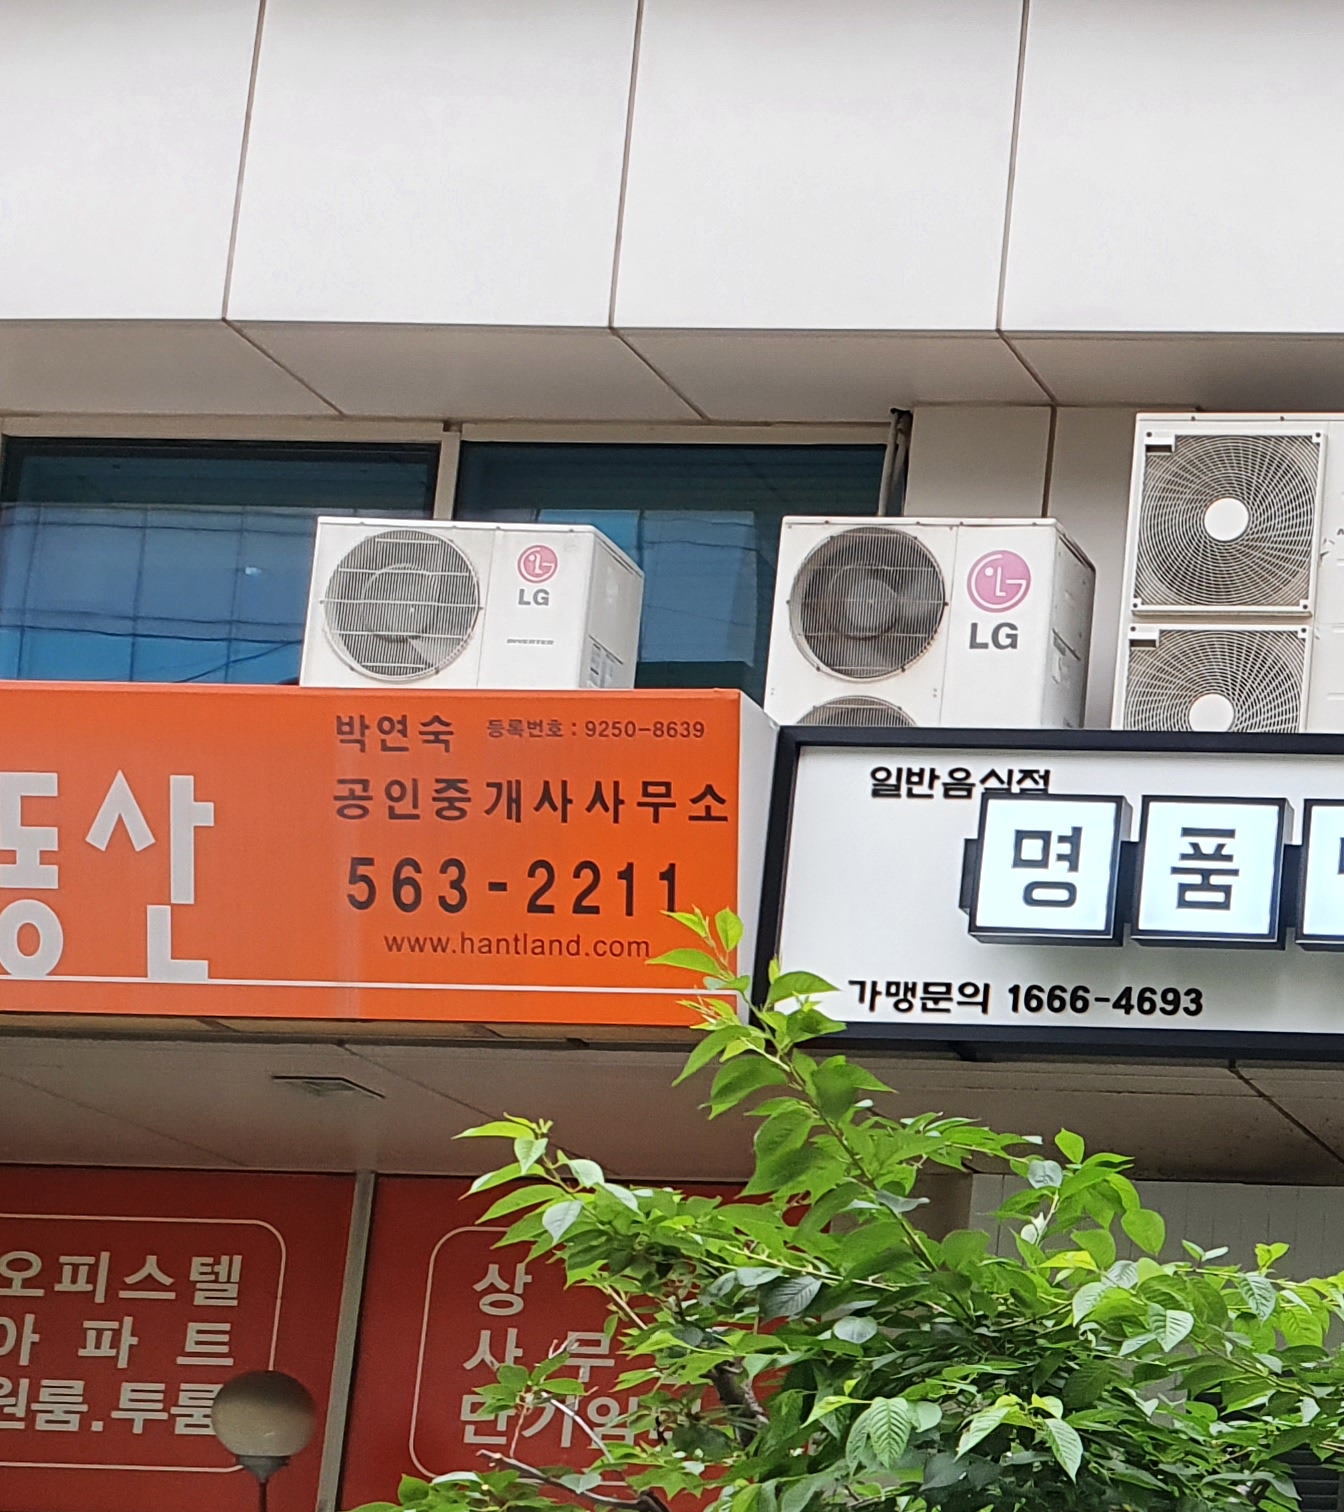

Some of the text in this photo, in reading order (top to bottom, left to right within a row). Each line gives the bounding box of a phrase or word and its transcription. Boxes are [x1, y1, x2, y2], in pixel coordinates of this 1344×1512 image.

[518, 589, 550, 606] LG
[968, 622, 1019, 651] LG
[336, 714, 455, 753] 박연숙
[486, 719, 564, 740] 등록번호
[584, 719, 706, 741] 9250-8639
[346, 856, 680, 917] 563-2211
[383, 933, 652, 959] www.hantland.com
[848, 979, 1204, 1017] 가맹문의 1666-4693
[0, 1251, 243, 1307] 오피스텔
